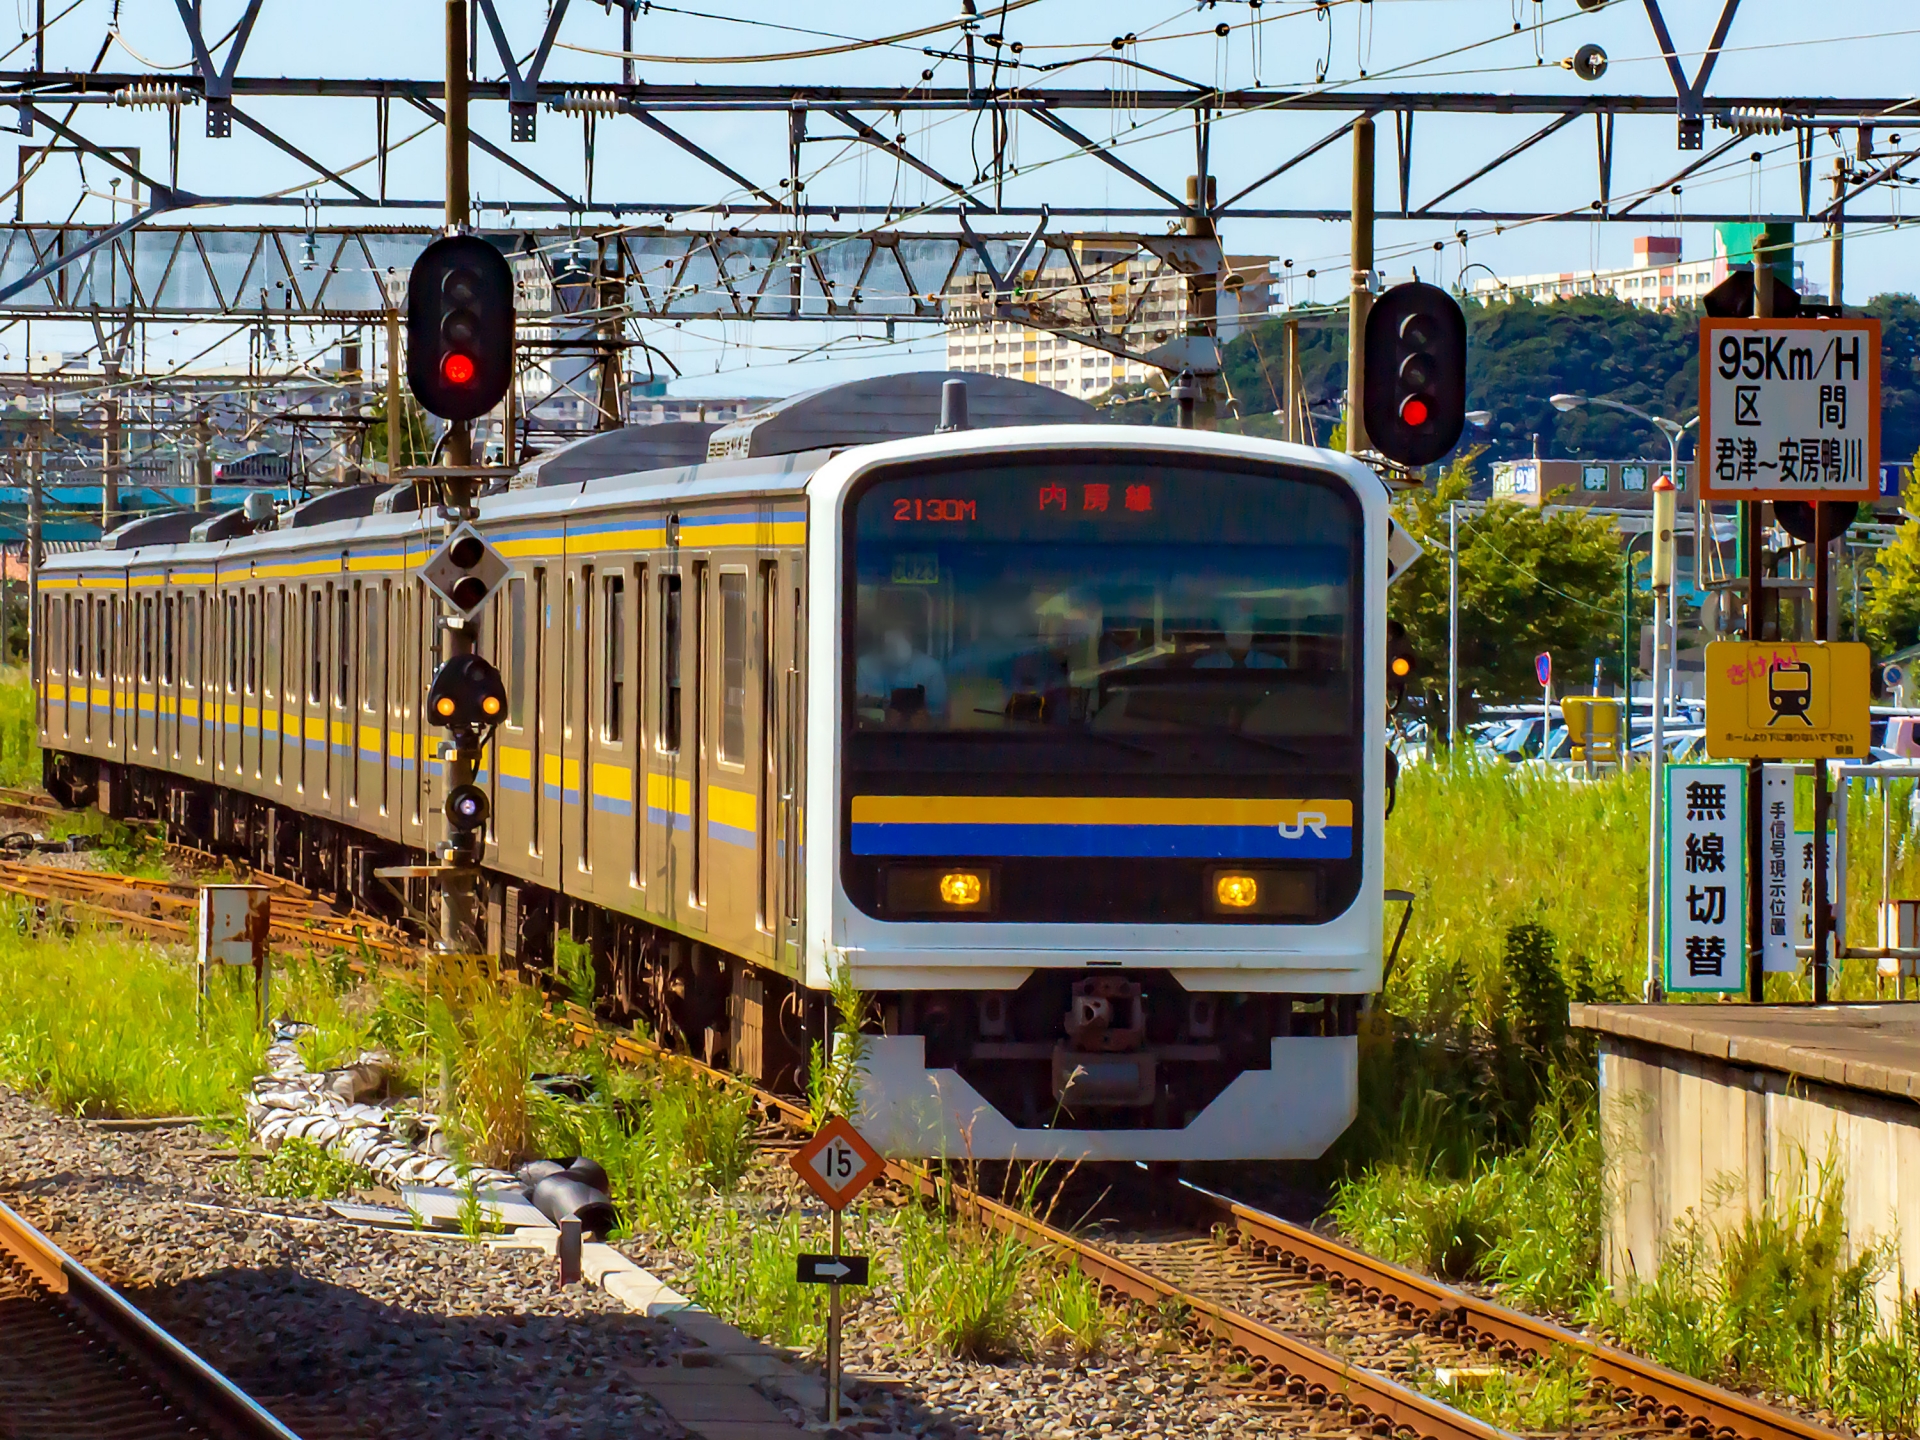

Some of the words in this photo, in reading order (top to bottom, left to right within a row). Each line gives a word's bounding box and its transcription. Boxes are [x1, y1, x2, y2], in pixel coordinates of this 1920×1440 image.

[1718, 335, 1859, 381] 95Km/H
[893, 498, 977, 522] 2130M
[1278, 811, 1327, 839] JR
[1685, 780, 1727, 977] 無線切替
[1769, 800, 1787, 937] 手信号現示位置
[826, 1146, 852, 1178] 15
